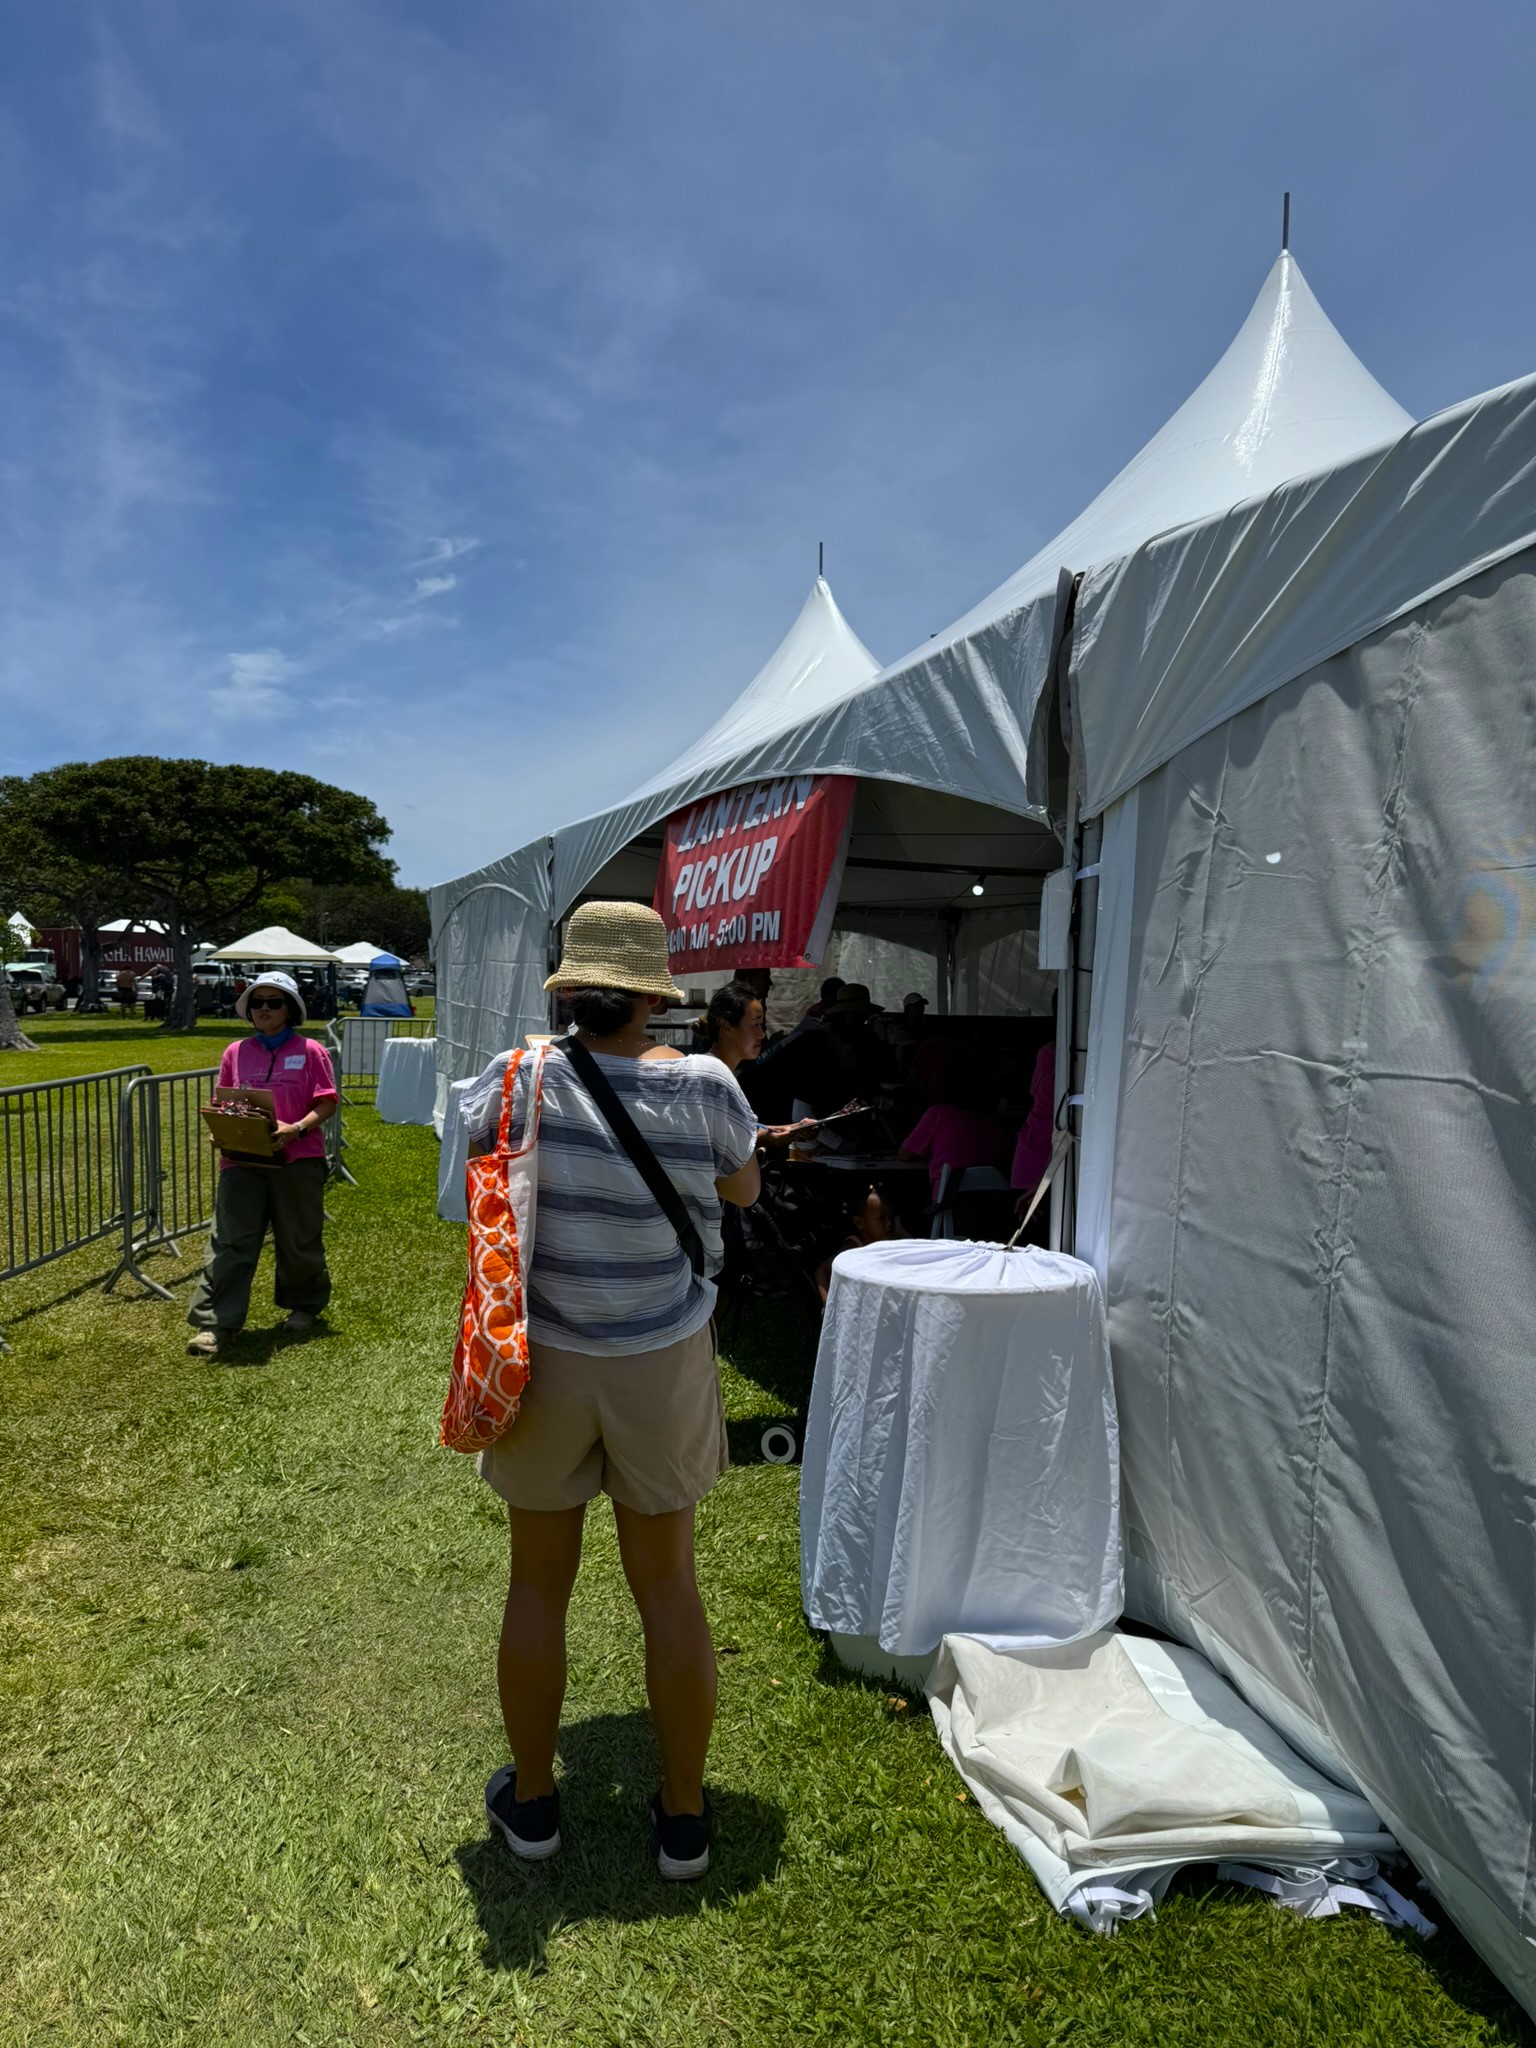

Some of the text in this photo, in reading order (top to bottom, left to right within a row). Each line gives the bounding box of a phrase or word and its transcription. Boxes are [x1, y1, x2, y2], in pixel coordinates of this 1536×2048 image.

[677, 775, 814, 852] LANTERN
[672, 836, 778, 915] PICKUP
[134, 946, 174, 963] HAWAII
[667, 925, 687, 954] 0:00
[689, 921, 710, 950] AM
[716, 914, 746, 947] 5:00
[751, 910, 781, 942] PM
